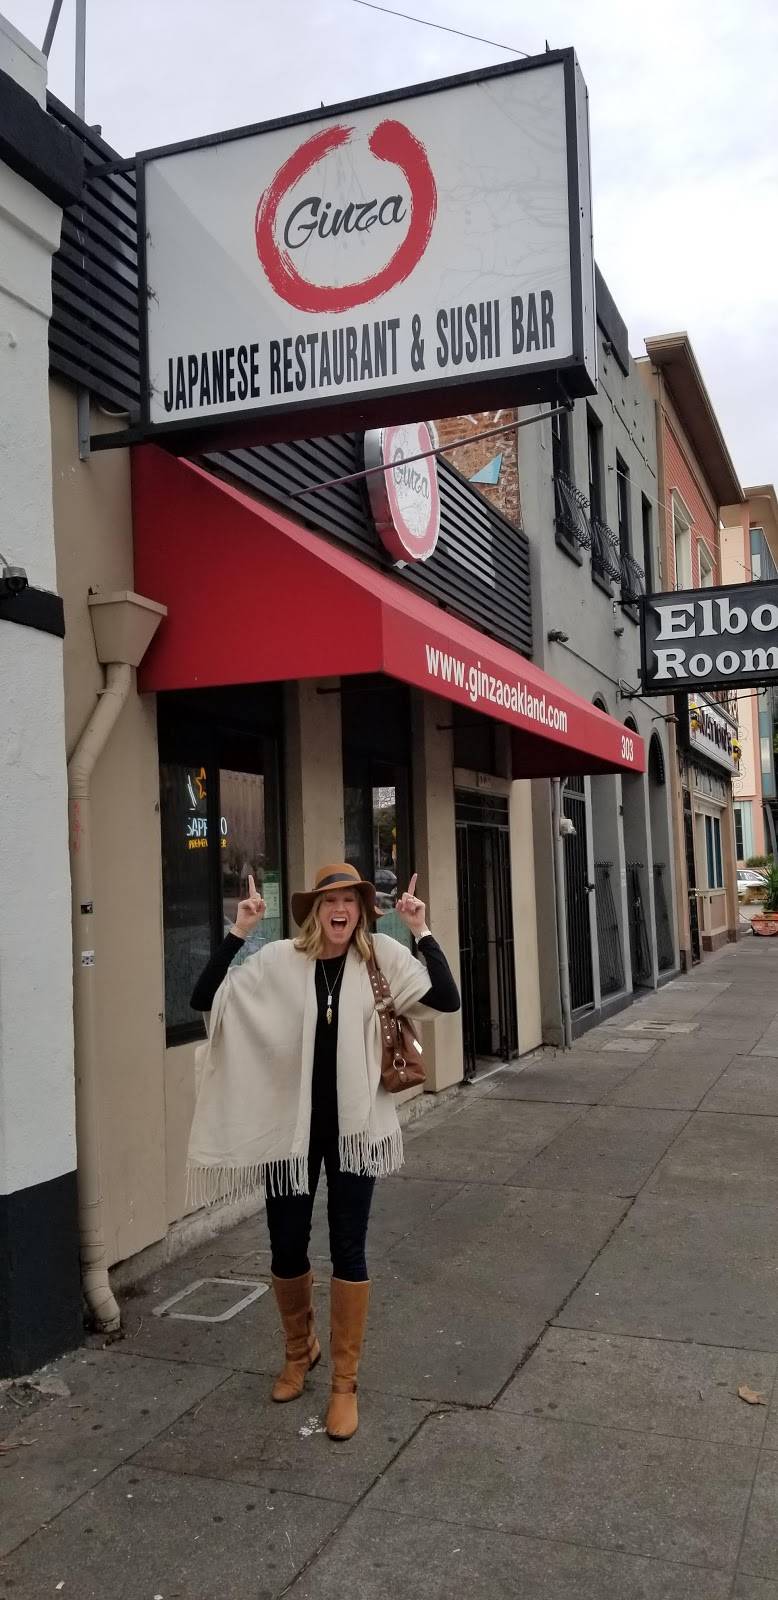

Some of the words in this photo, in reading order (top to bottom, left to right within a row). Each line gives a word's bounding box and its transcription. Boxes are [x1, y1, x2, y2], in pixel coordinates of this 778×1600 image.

[284, 194, 407, 249] Ginza
[163, 343, 261, 412] JAPANESE
[270, 318, 400, 394] RESTAURANT
[411, 313, 425, 373] &
[437, 299, 500, 368] SUSHI
[511, 289, 556, 355] BAR
[654, 597, 778, 641] Elbo
[652, 647, 778, 680] Room
[425, 644, 568, 733] www.ginzaoakland.com
[621, 735, 634, 762] 303
